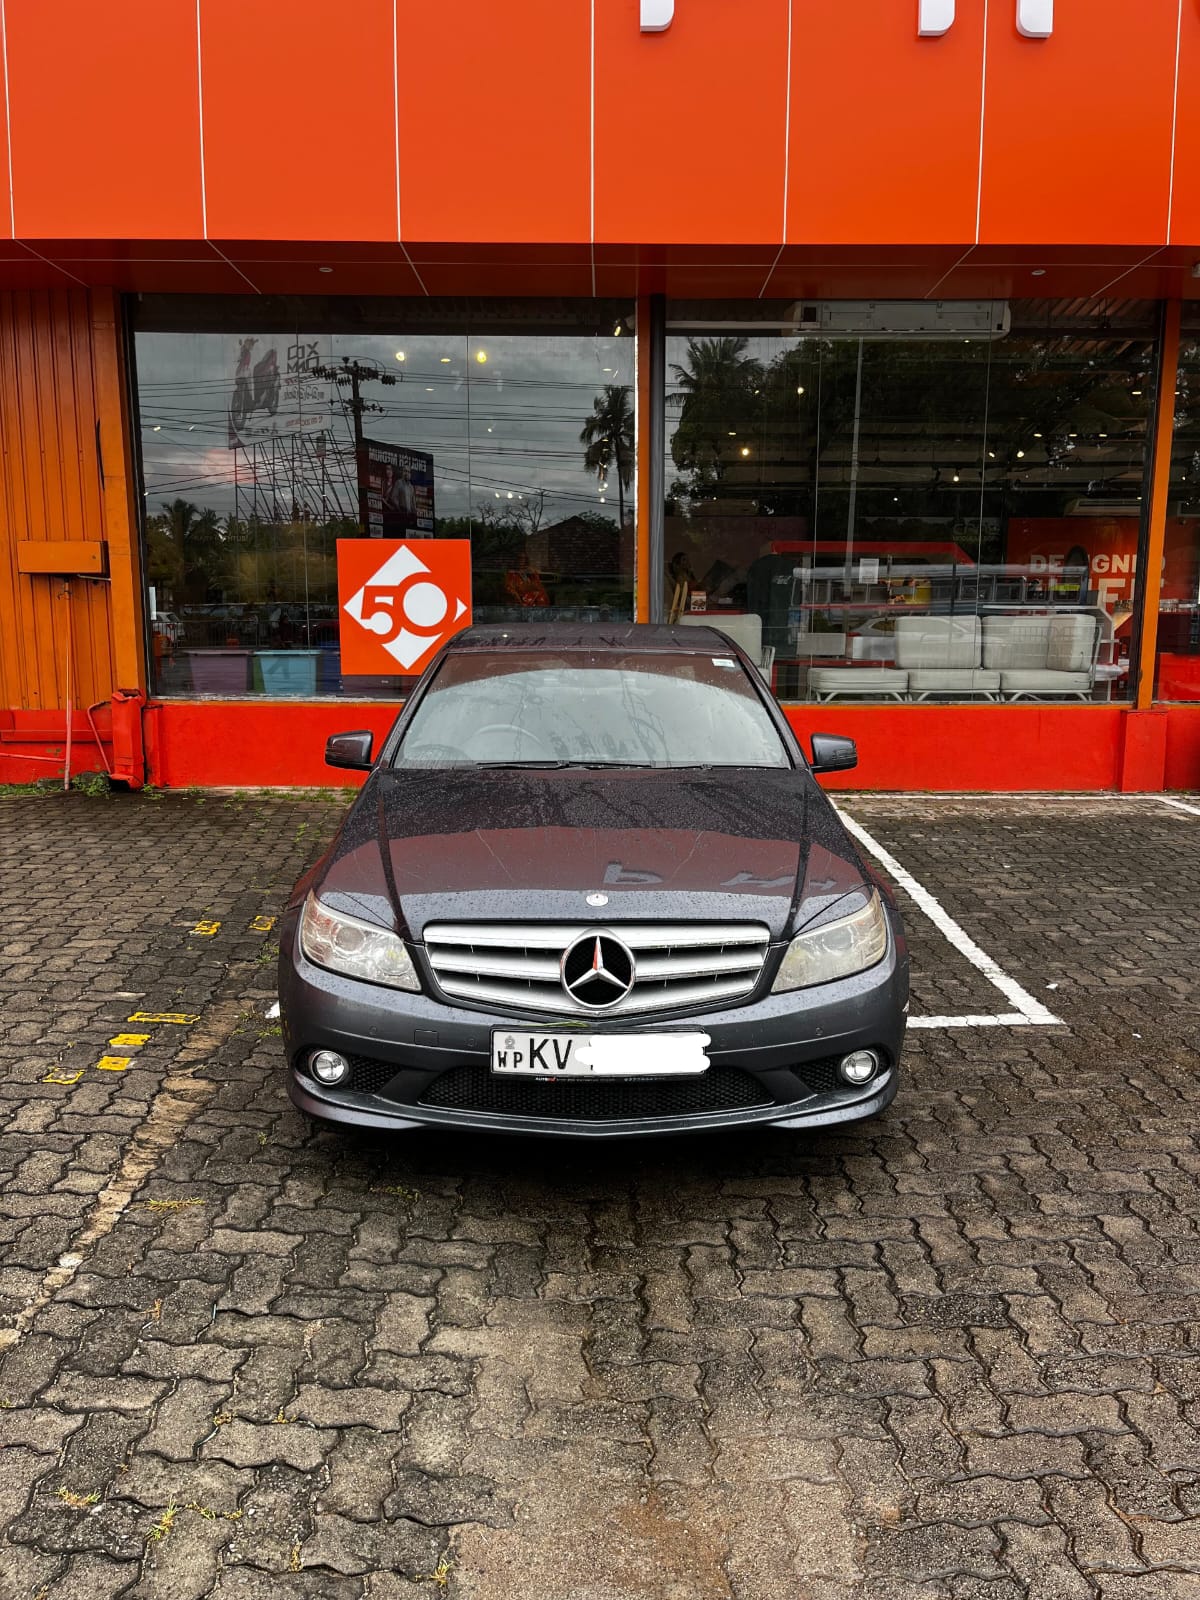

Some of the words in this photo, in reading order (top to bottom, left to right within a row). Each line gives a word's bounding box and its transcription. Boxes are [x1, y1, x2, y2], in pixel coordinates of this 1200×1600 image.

[361, 571, 458, 645] 50
[497, 1050, 523, 1069] WP
[529, 1037, 573, 1070] KV
